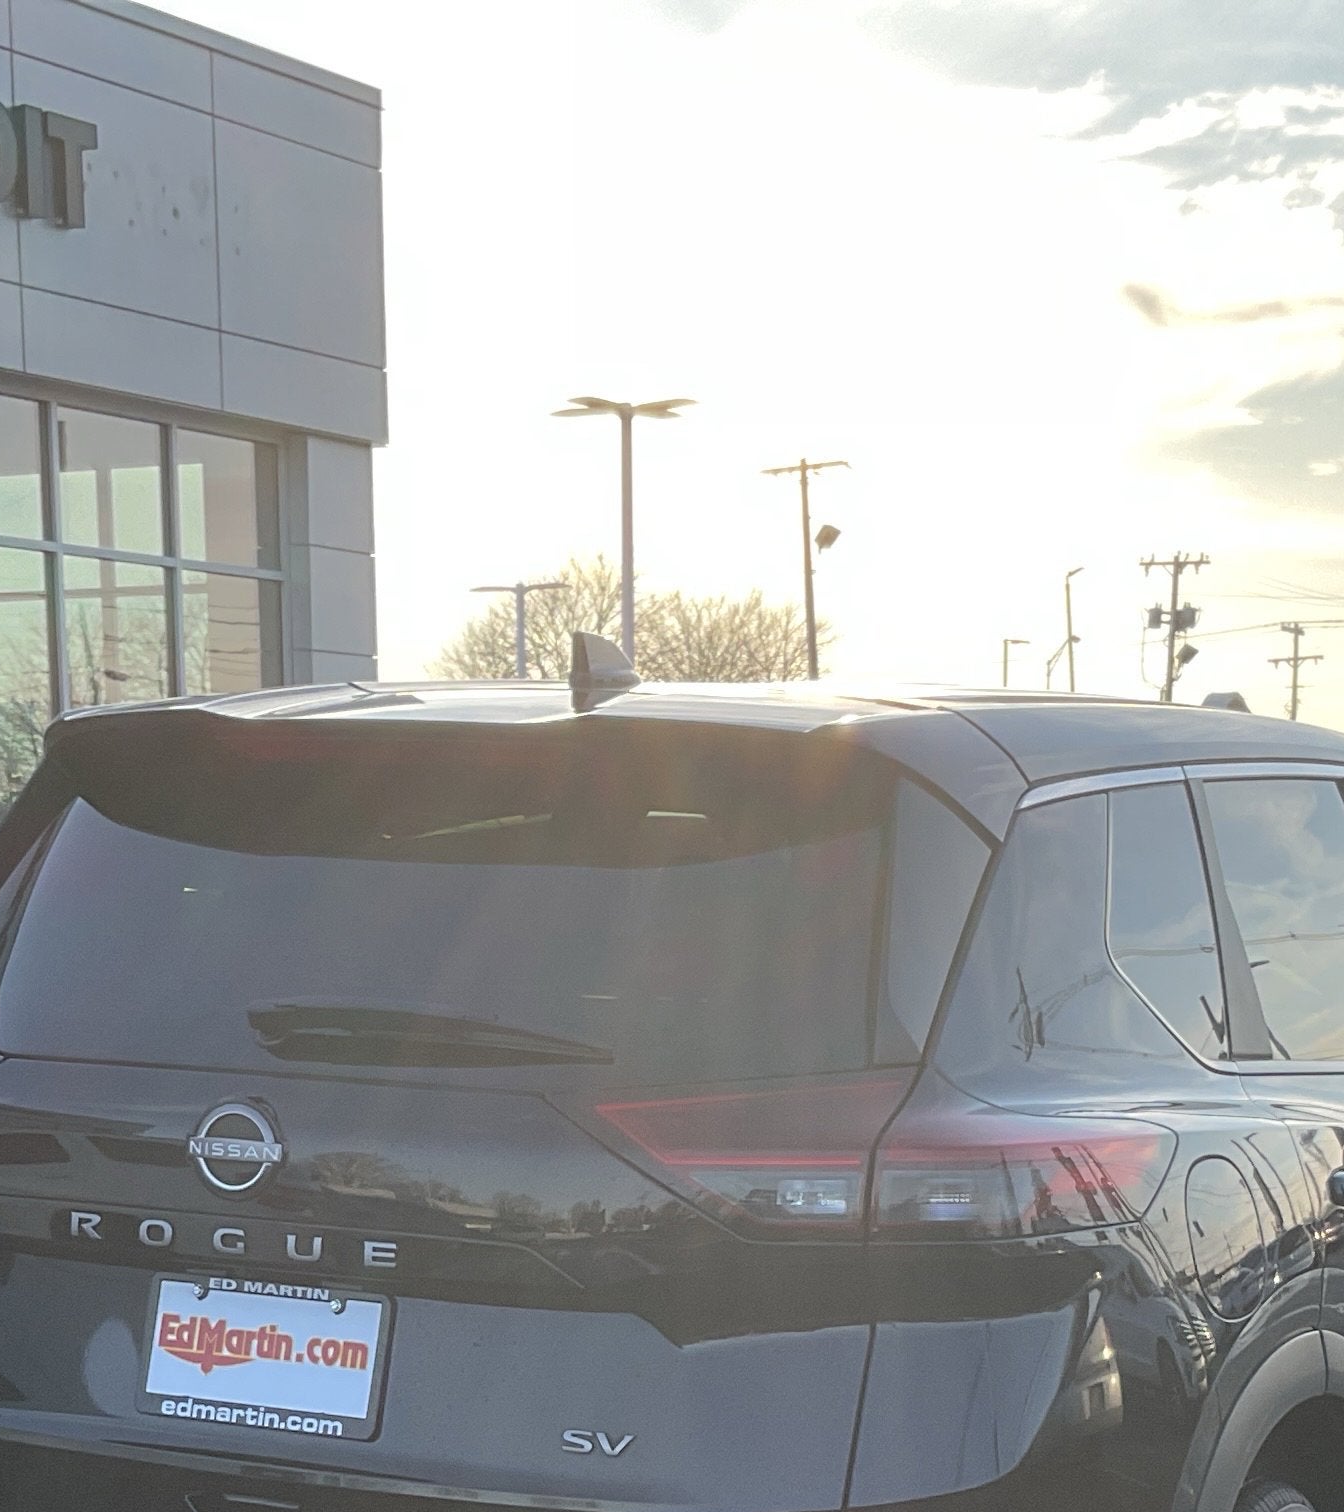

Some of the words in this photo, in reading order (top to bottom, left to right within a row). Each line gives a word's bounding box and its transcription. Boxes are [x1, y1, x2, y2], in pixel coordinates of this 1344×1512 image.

[189, 1139, 280, 1162] NISSAN
[70, 1211, 398, 1268] ROGUE
[208, 1277, 237, 1291] ED
[243, 1280, 330, 1301] MARTIN
[158, 1312, 369, 1371] EdMartin.com
[160, 1398, 343, 1436] edmartin.com
[561, 1429, 635, 1456] SV
